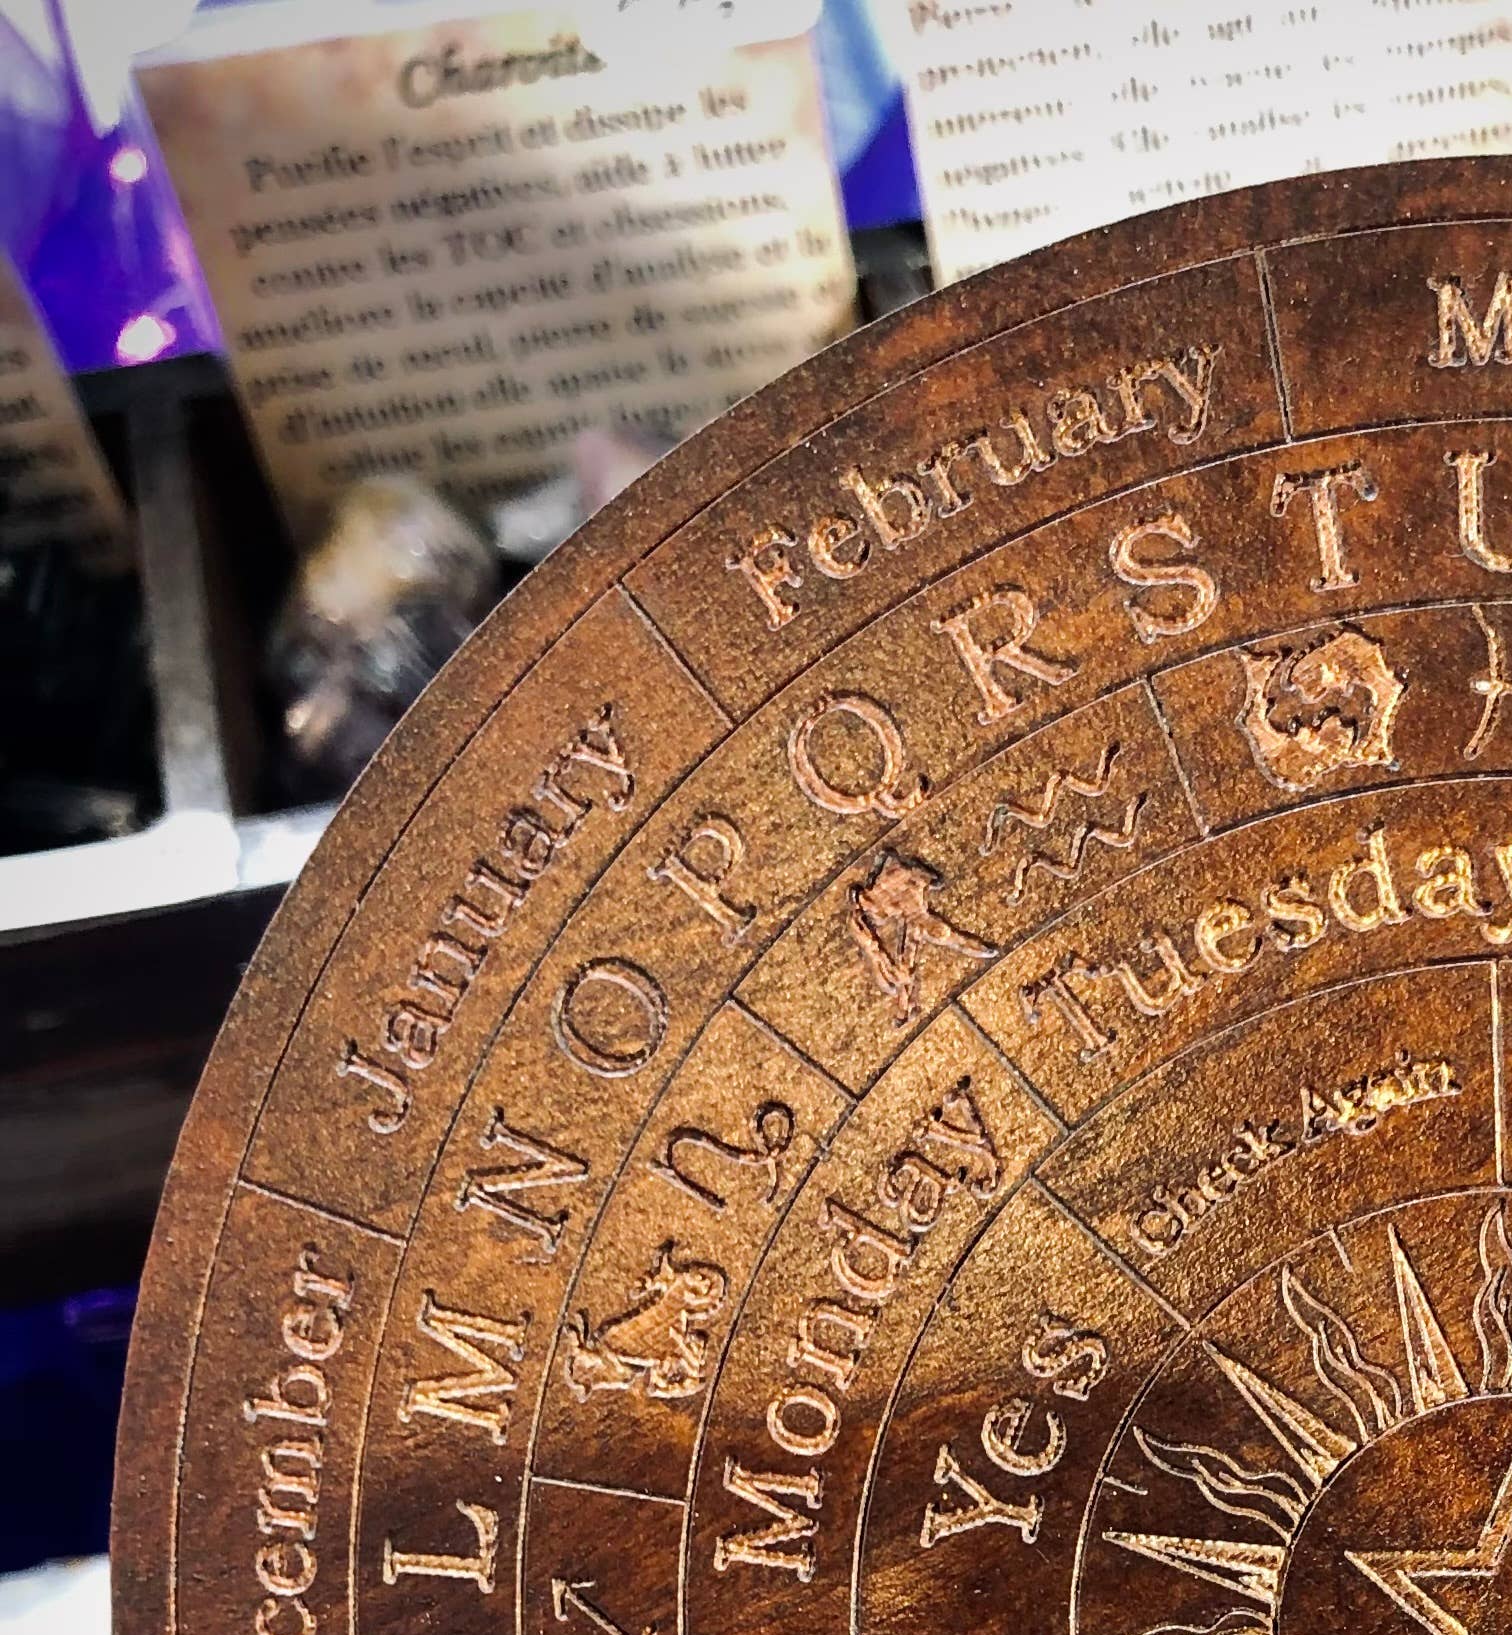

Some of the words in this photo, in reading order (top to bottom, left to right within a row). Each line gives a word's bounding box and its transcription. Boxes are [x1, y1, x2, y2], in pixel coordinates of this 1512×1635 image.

[725, 342, 1222, 631] February
[1269, 459, 1379, 594] T
[1108, 511, 1222, 645] S
[930, 584, 1079, 726] R
[787, 692, 932, 819] Q
[336, 703, 637, 1134] January
[647, 811, 758, 949] P
[552, 956, 671, 1080] O
[453, 1107, 589, 1256] N
[1131, 1119, 1299, 1257] Check
[1299, 1049, 1461, 1144] Again
[397, 1289, 532, 1446] M
[714, 1074, 999, 1583] Monday
[920, 1311, 1109, 1549] Yes
[382, 1499, 501, 1595] L
